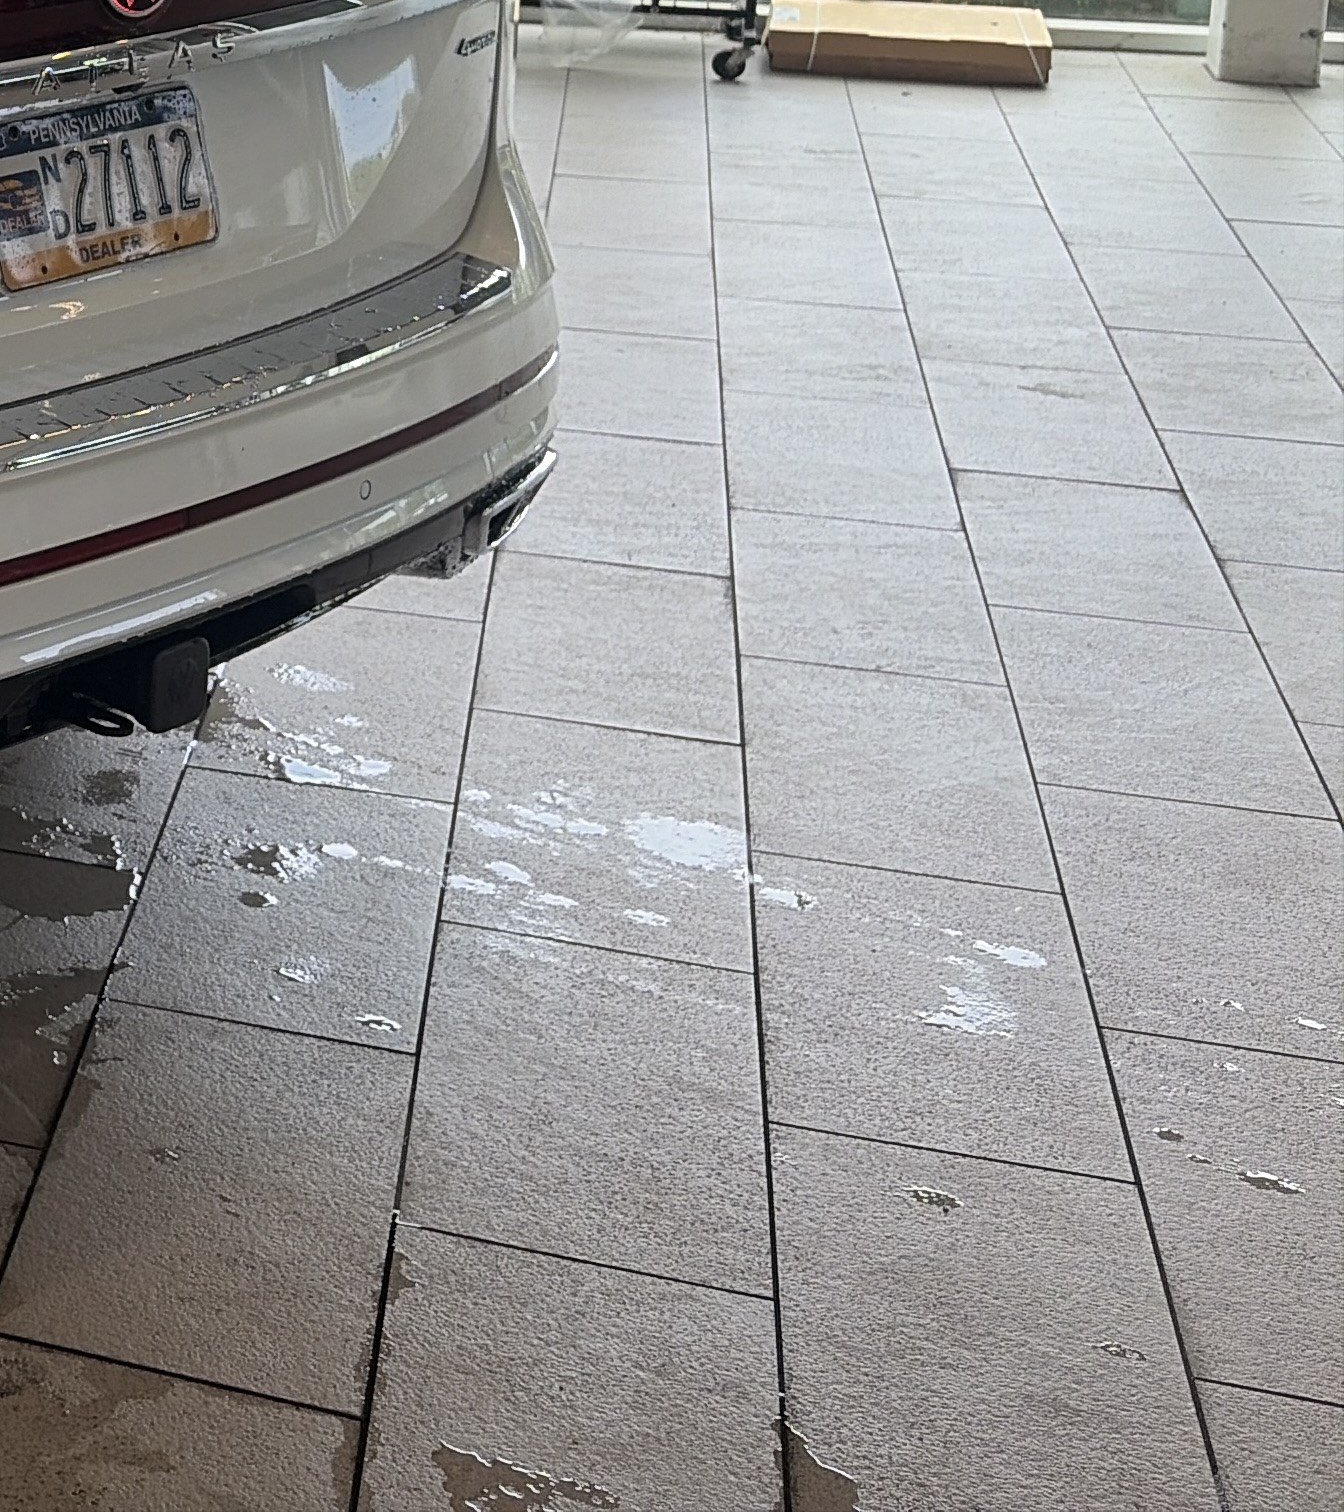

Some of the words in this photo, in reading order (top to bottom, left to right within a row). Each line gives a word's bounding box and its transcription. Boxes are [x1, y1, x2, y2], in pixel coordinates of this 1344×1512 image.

[32, 32, 236, 96] ATLAS
[29, 104, 142, 145] PENNSYLVANIA
[65, 128, 201, 235] 27112
[78, 233, 143, 264] DEALER
